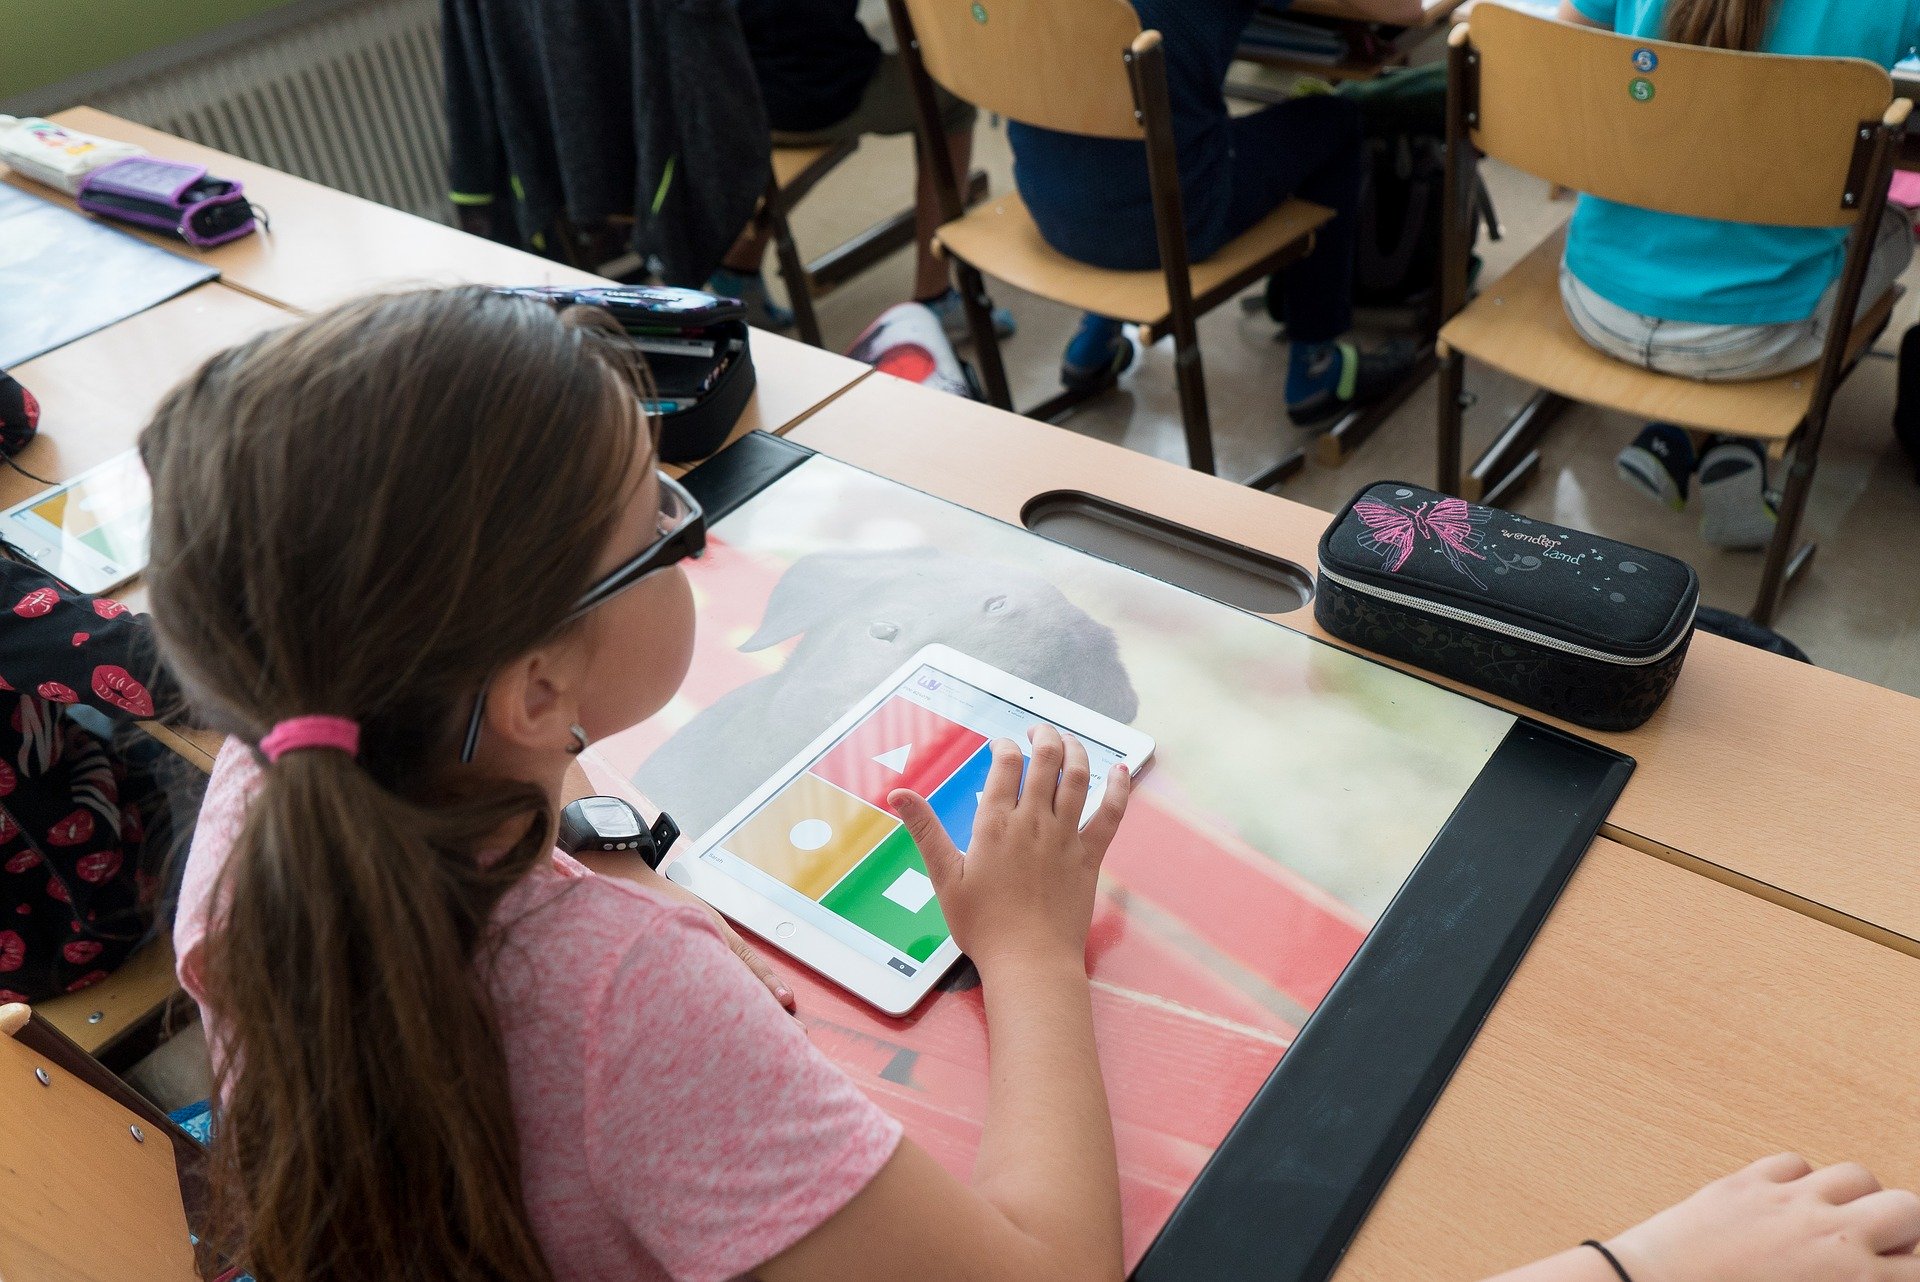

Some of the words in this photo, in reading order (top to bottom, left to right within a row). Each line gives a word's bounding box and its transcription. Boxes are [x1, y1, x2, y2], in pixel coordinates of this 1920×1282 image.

[1635, 81, 1649, 100] 5
[1501, 529, 1562, 548] wonder
[1542, 545, 1586, 566] land
